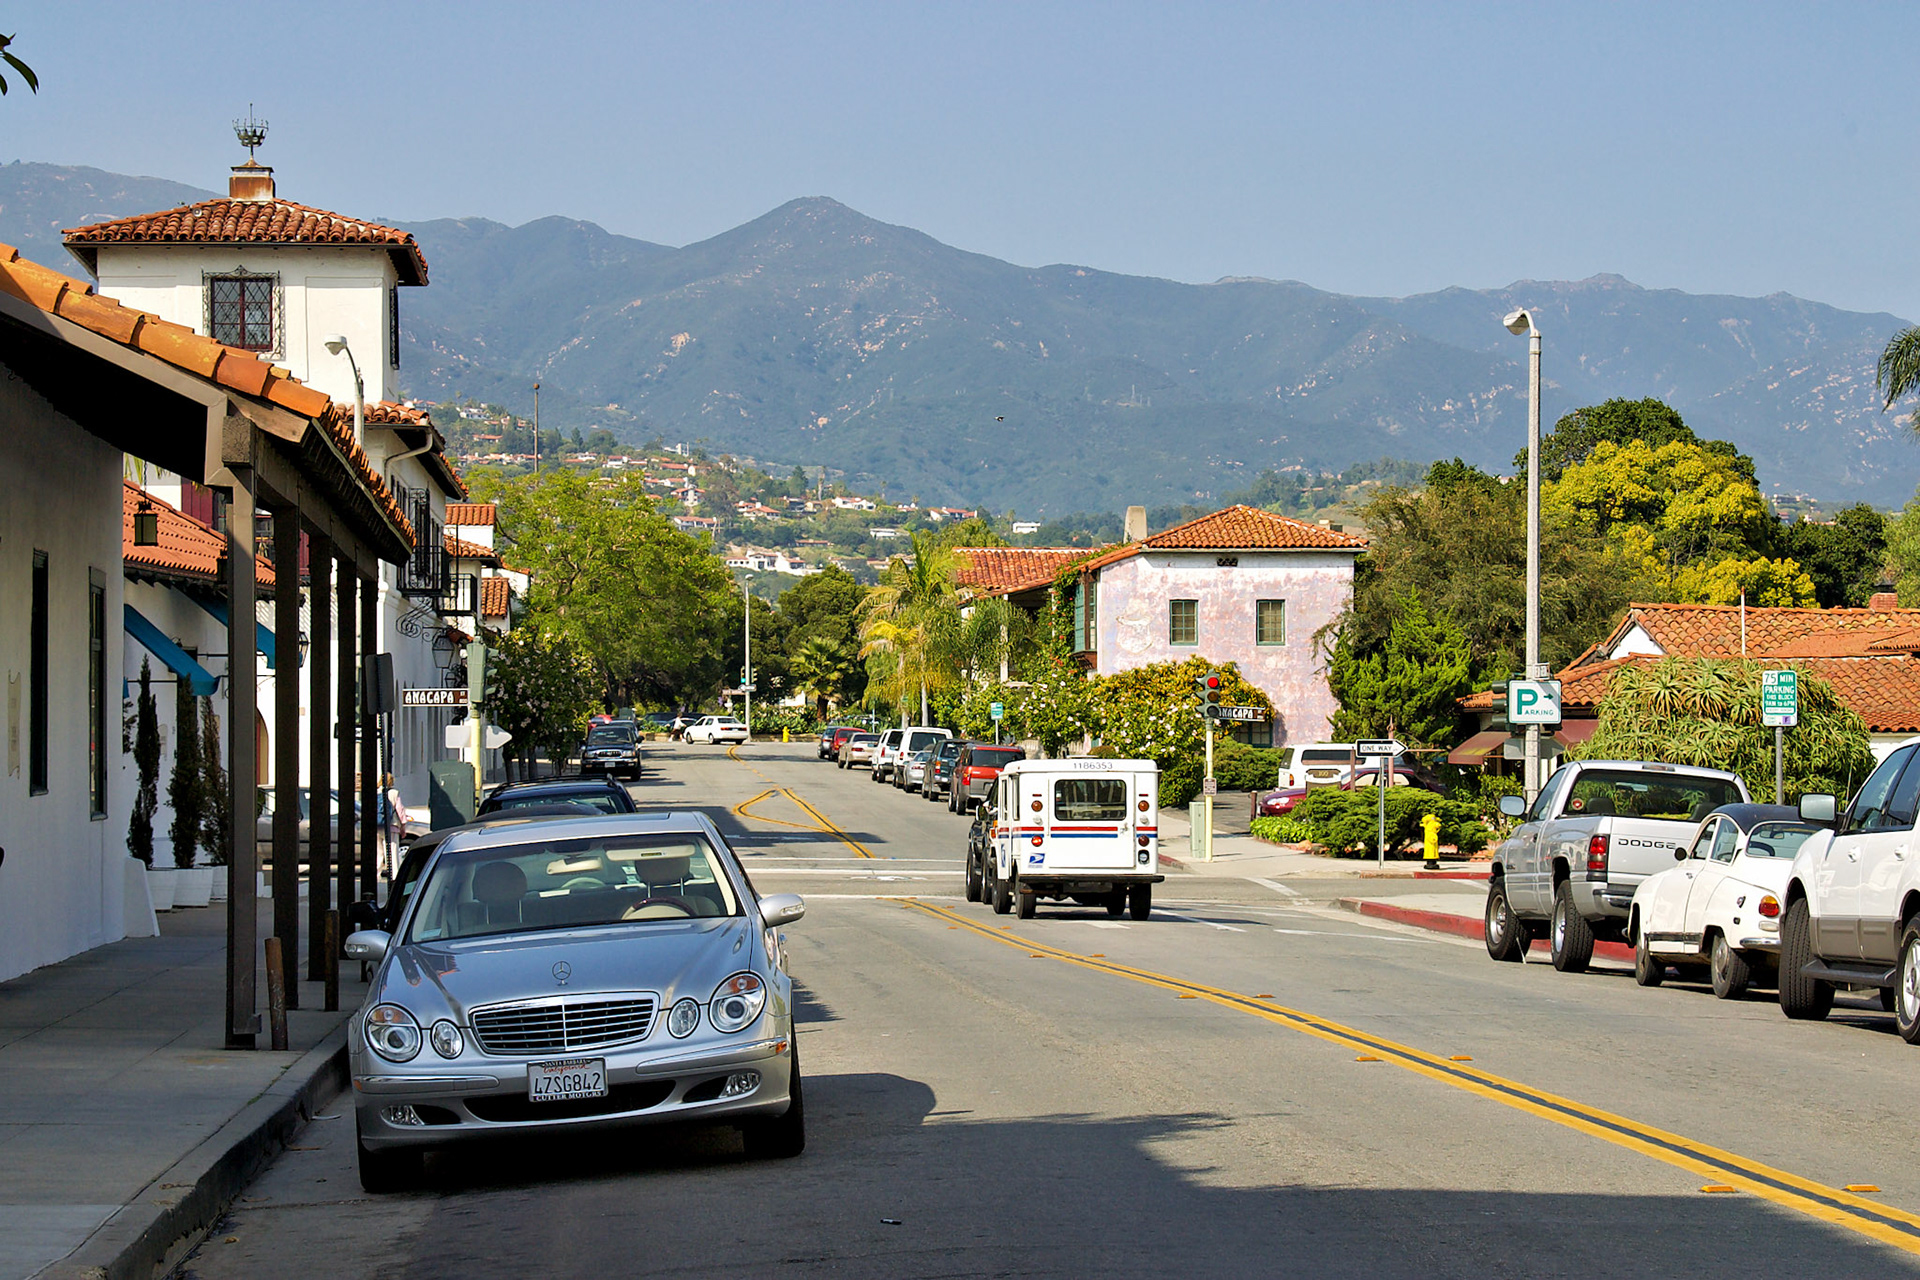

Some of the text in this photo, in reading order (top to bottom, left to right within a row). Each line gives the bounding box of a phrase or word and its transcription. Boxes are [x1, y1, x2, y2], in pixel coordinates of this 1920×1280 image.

[1765, 673, 1794, 684] 75 MIN
[1764, 685, 1795, 695] PARKING
[405, 691, 454, 704] ANACAPA
[1219, 708, 1253, 719] NACAPA
[1361, 744, 1375, 752] ONE
[1073, 761, 1113, 770] 1186353
[1618, 838, 1677, 850] DODGE
[534, 1072, 602, 1094] 4ZSG842
[535, 1091, 602, 1101] CUTTER MOTORS
